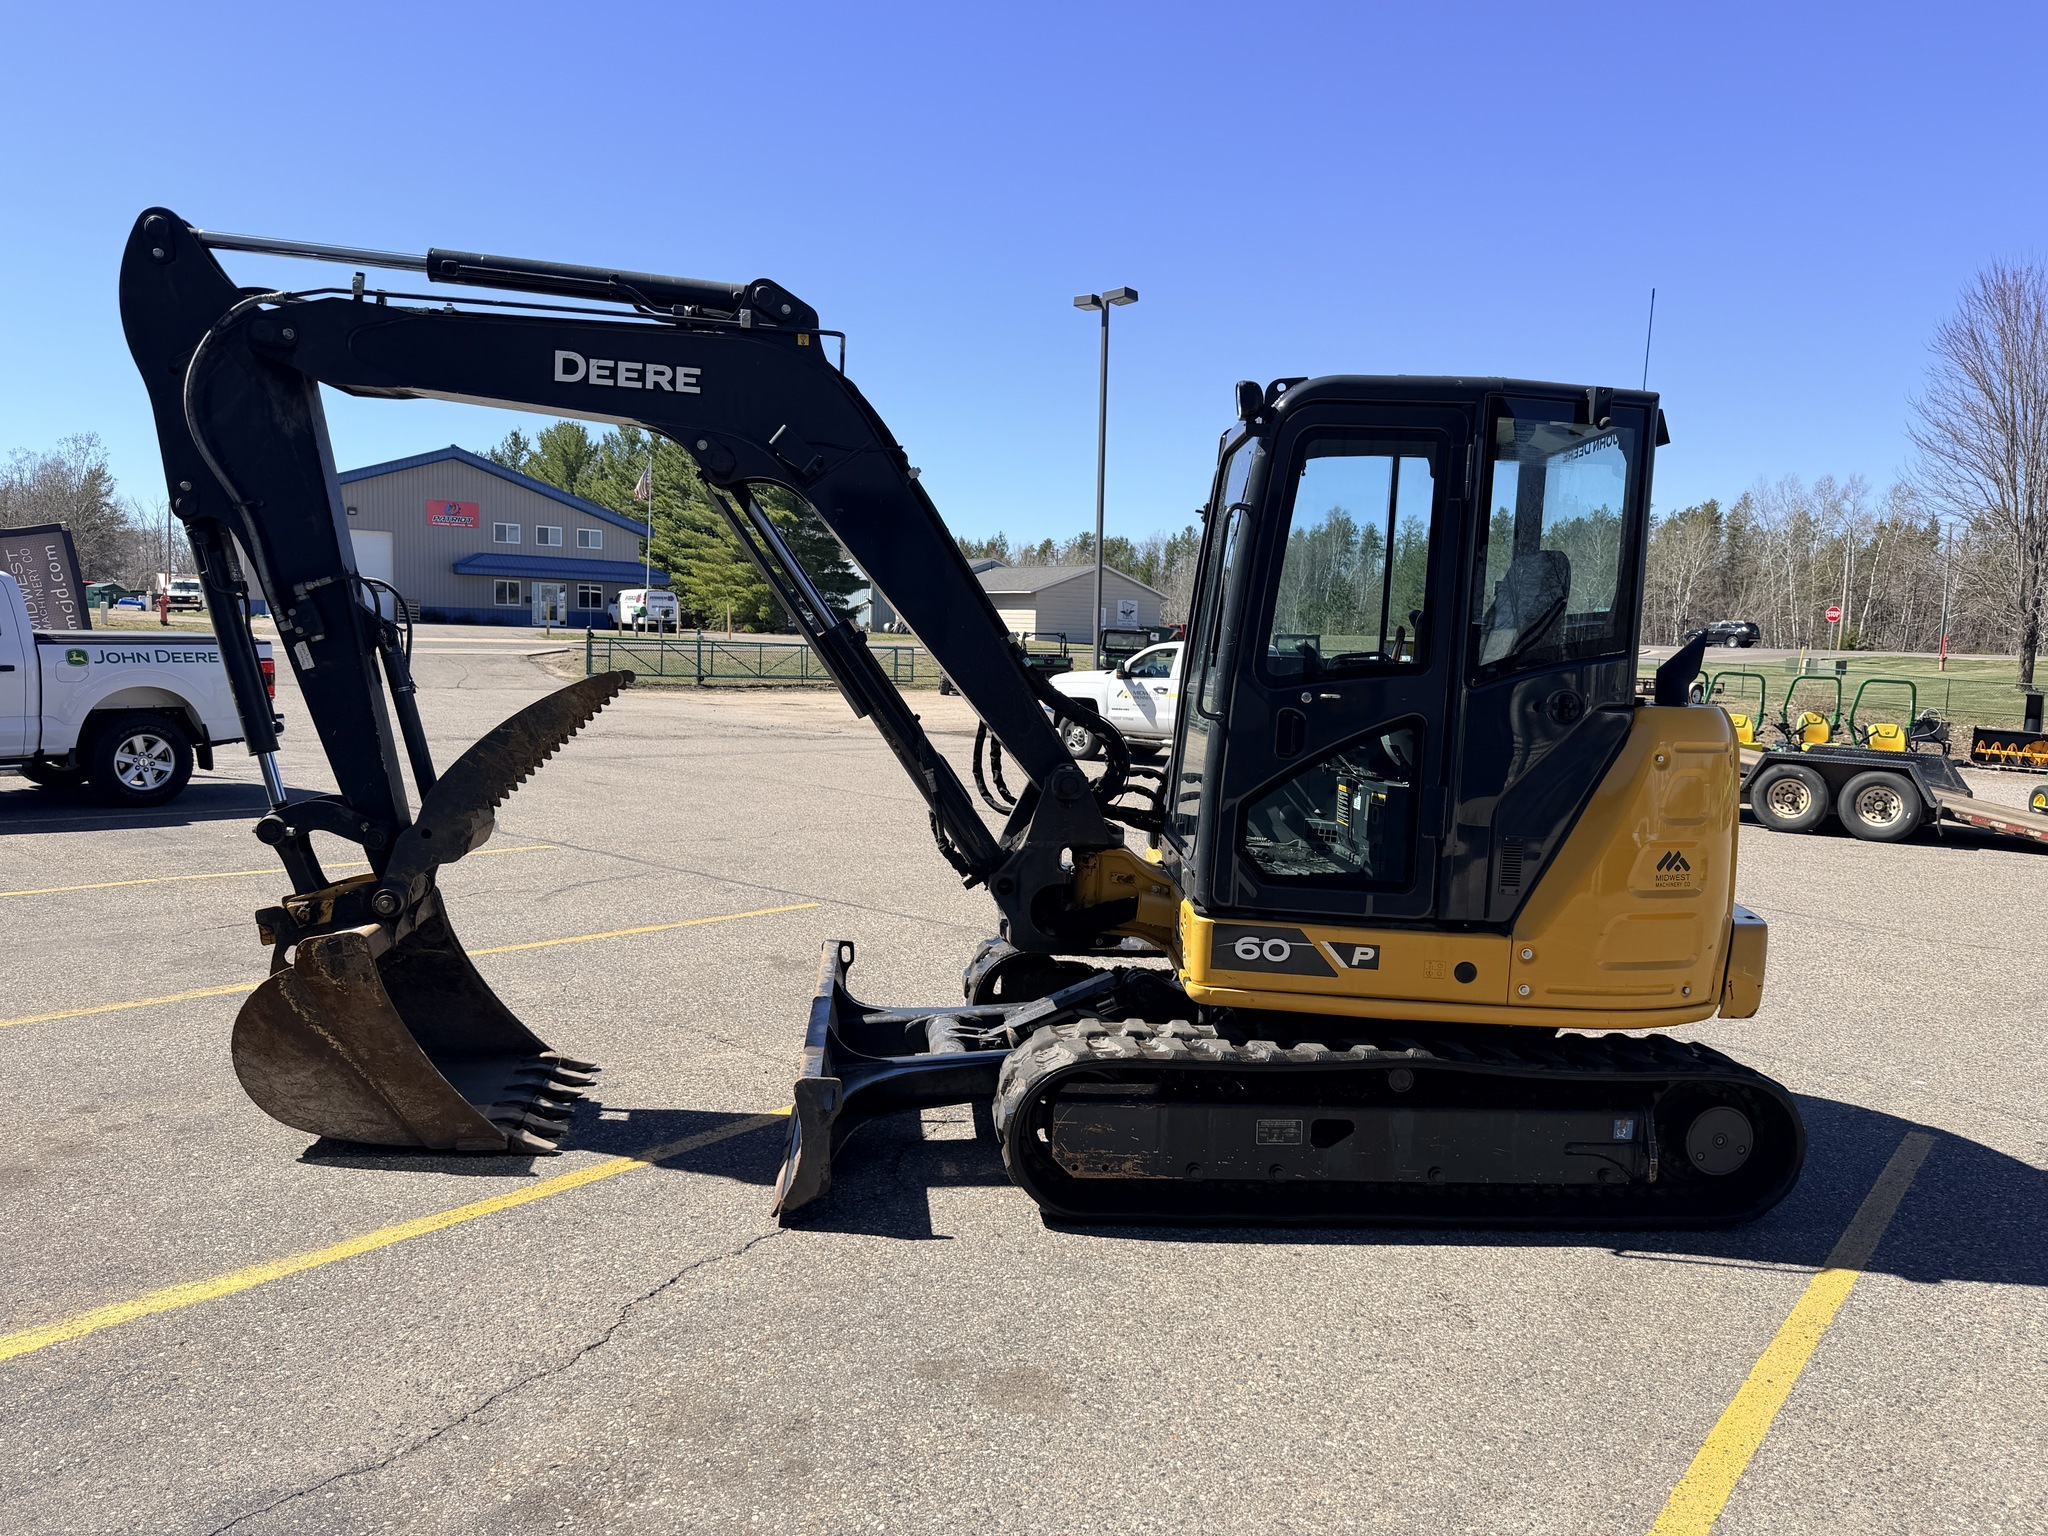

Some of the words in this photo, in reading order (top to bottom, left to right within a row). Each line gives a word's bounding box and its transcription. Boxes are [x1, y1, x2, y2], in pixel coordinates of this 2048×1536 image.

[554, 349, 702, 394] DEERE
[432, 515, 474, 524] PATRIOT
[20, 548, 33, 563] CO
[94, 649, 151, 664] JOHN
[154, 649, 220, 663] DEERE
[1235, 937, 1291, 962] 60
[1351, 946, 1375, 966] P
